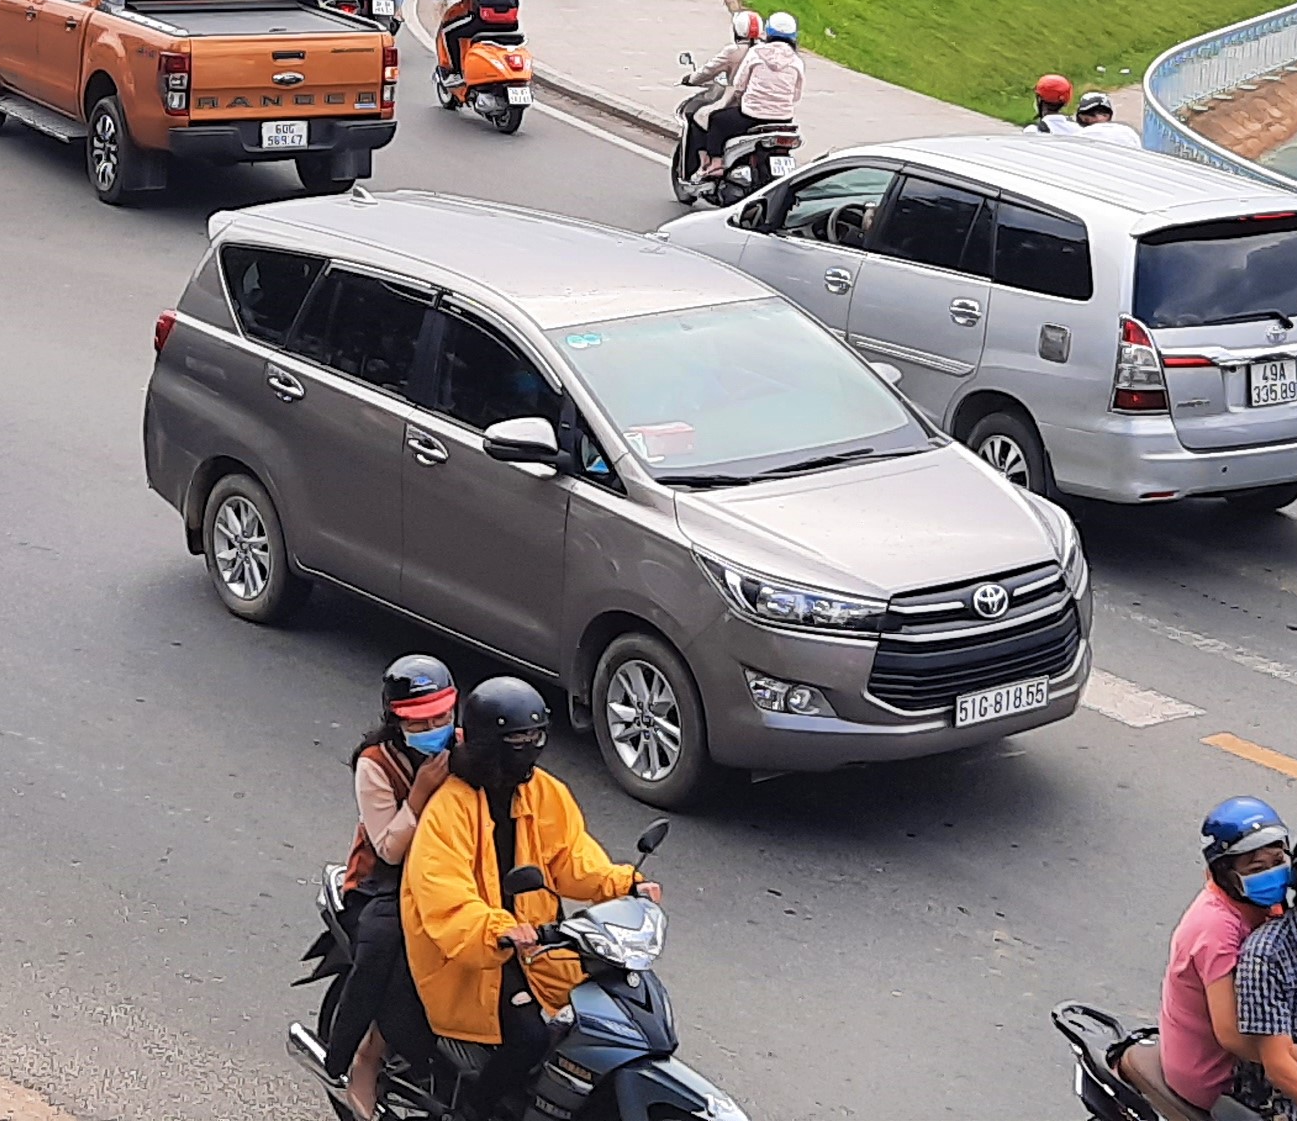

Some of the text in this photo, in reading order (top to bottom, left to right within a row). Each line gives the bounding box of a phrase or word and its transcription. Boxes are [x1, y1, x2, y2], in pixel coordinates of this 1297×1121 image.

[1262, 362, 1286, 381] 49A
[1253, 381, 1297, 404] 335.89
[959, 681, 1046, 722] 51G-818.55
